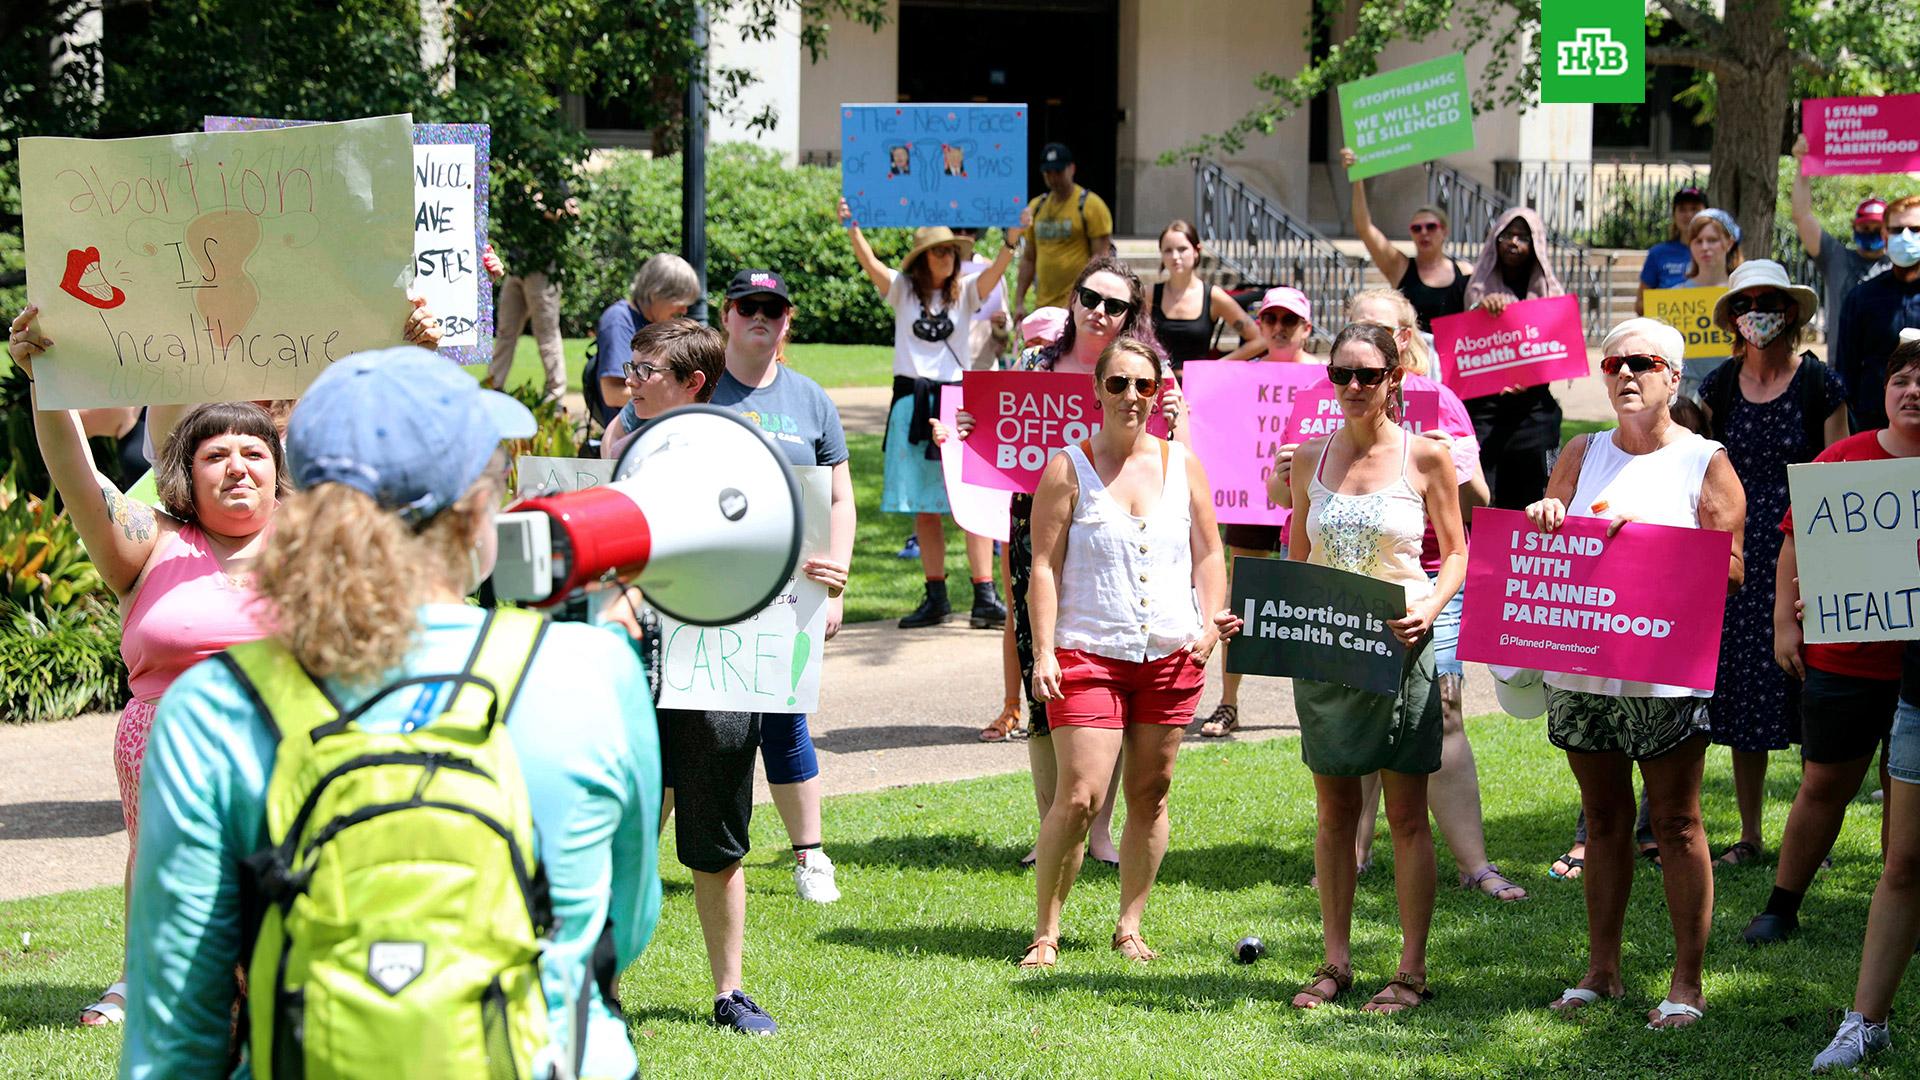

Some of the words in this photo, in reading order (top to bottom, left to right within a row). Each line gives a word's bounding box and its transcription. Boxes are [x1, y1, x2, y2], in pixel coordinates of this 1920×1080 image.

[857, 109, 897, 133] The
[913, 110, 961, 133] New
[968, 109, 1015, 133] Face
[1354, 114, 1379, 131] WE
[1383, 104, 1421, 123] WILL
[1425, 92, 1460, 112] NOT
[1825, 107, 1830, 118] I
[1833, 104, 1878, 118] STAND
[1825, 118, 1862, 129] WITH
[1356, 130, 1376, 148] BE
[1380, 109, 1460, 141] SILENCED
[1825, 129, 1888, 142] PLANNED
[1825, 140, 1918, 155] PARENTHOOD
[977, 156, 1013, 178] PMS
[55, 158, 314, 216] abortion
[163, 237, 219, 286] IS
[1657, 300, 1706, 317] BANS
[1454, 330, 1522, 354] Abortion
[1525, 324, 1539, 339] is
[1684, 331, 1733, 346] DIES
[1456, 346, 1516, 370] Health
[1518, 339, 1567, 358] Care.
[999, 391, 1083, 420] BANS
[996, 418, 1058, 444] OFF
[1215, 489, 1249, 508] OUR
[1511, 530, 1519, 549] I
[1524, 532, 1604, 557] STAND
[1510, 554, 1571, 579] WITH
[1505, 578, 1617, 607] PLANNED
[1260, 600, 1360, 629] Abortion
[1365, 613, 1384, 633] is
[1260, 621, 1333, 646] Health
[1338, 632, 1393, 657] Care.
[1509, 636, 1544, 649] Planned
[1545, 640, 1598, 655] Parenthood
